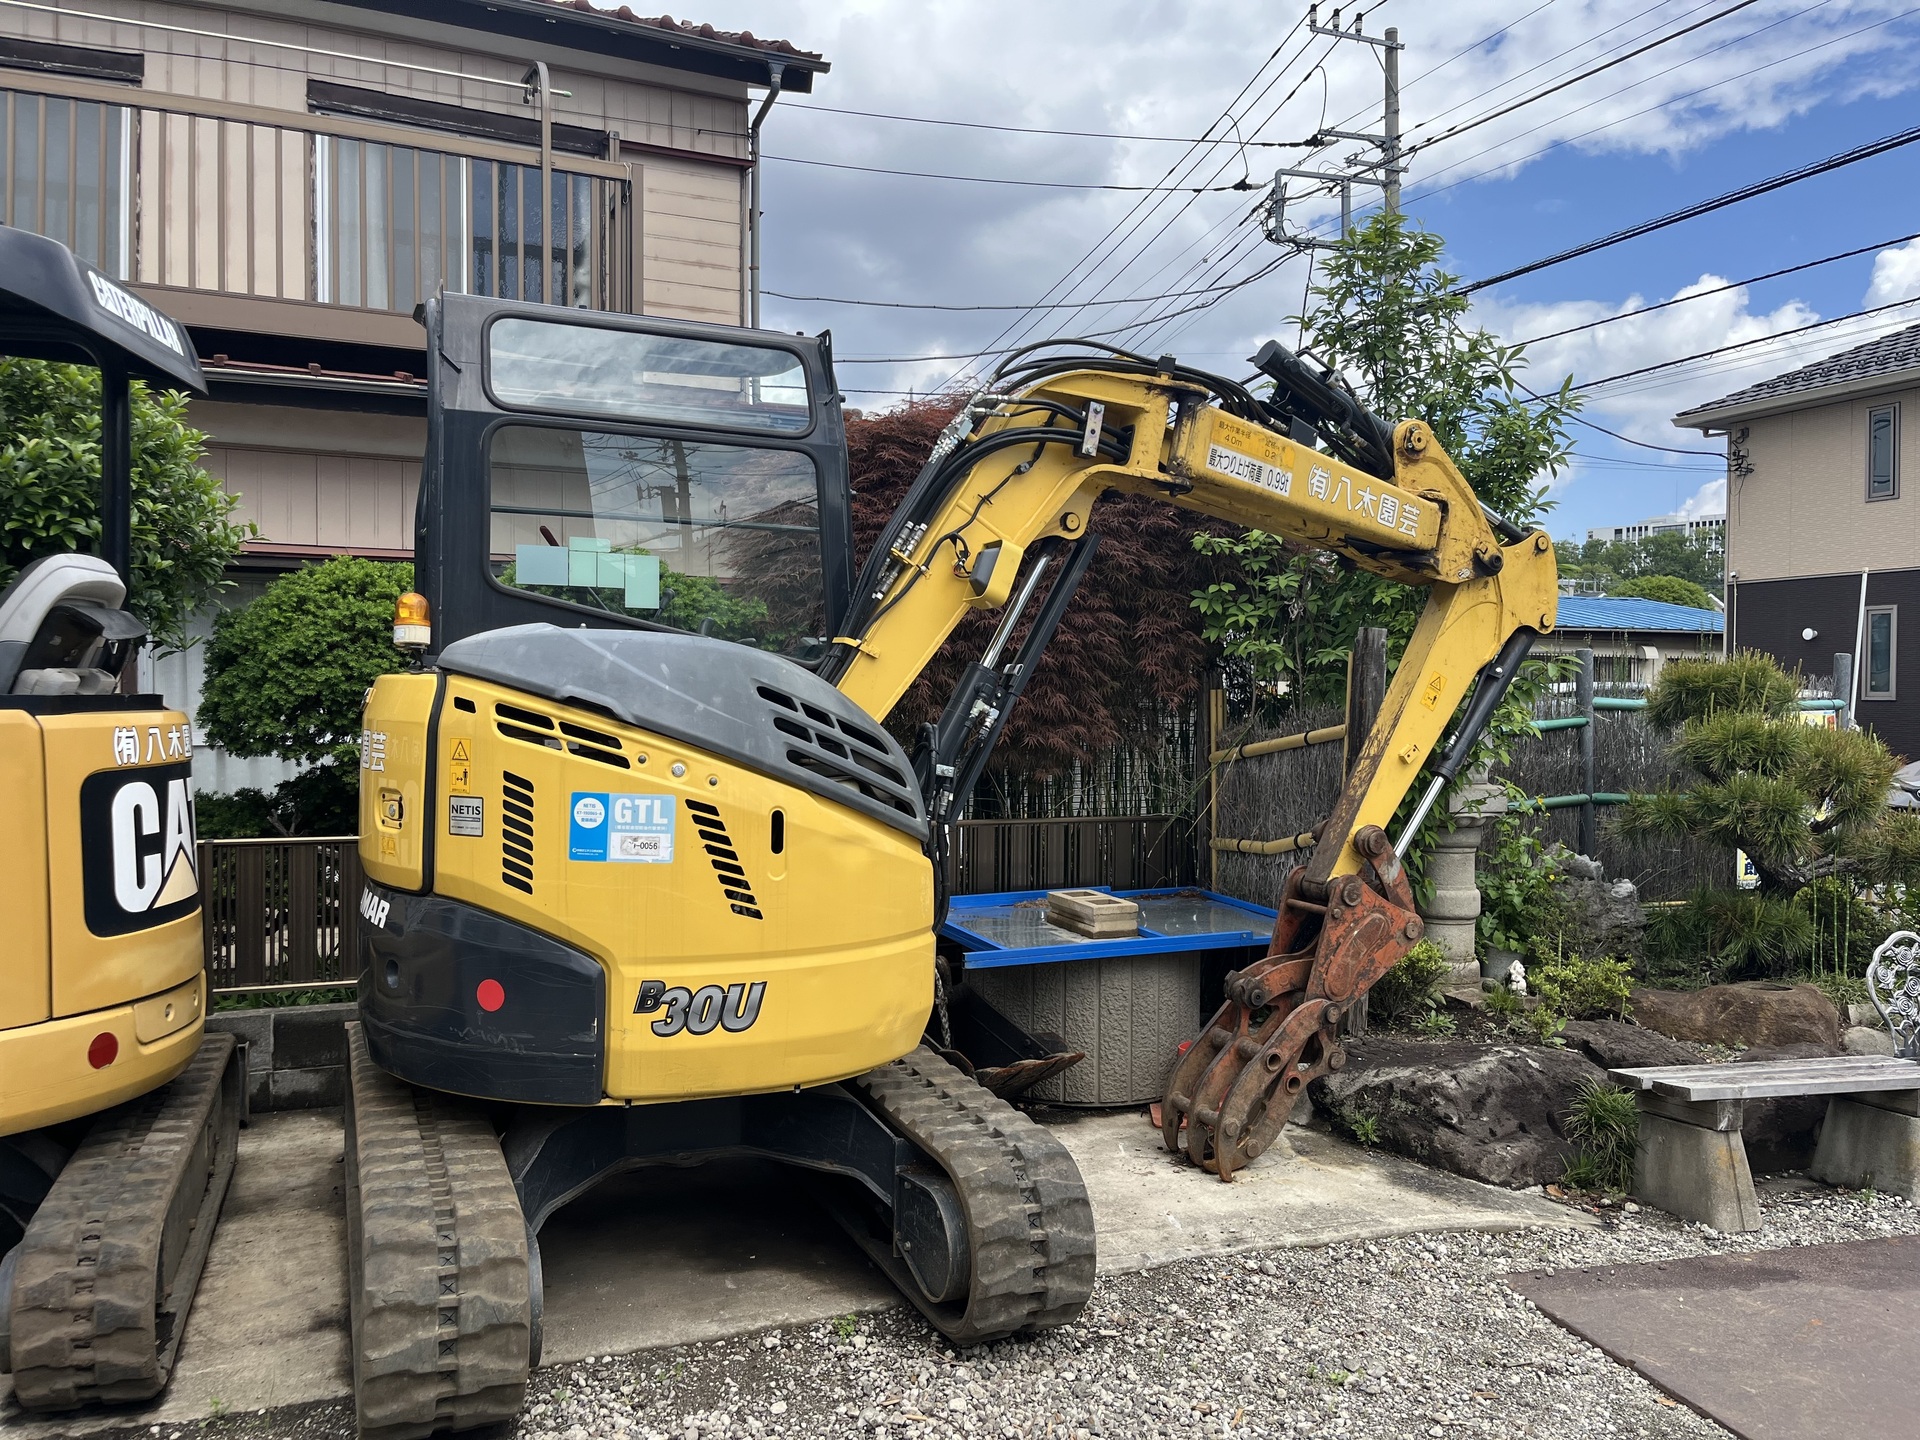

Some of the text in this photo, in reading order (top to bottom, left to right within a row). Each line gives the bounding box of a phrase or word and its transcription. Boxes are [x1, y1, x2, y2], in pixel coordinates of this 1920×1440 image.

[87, 270, 184, 356] CATERPILLAR
[1208, 448, 1289, 492] 最大つり上げ荷重 0.99t
[451, 804, 481, 815] NETIS
[614, 798, 668, 824] GTL
[632, 979, 768, 1038] B30U
